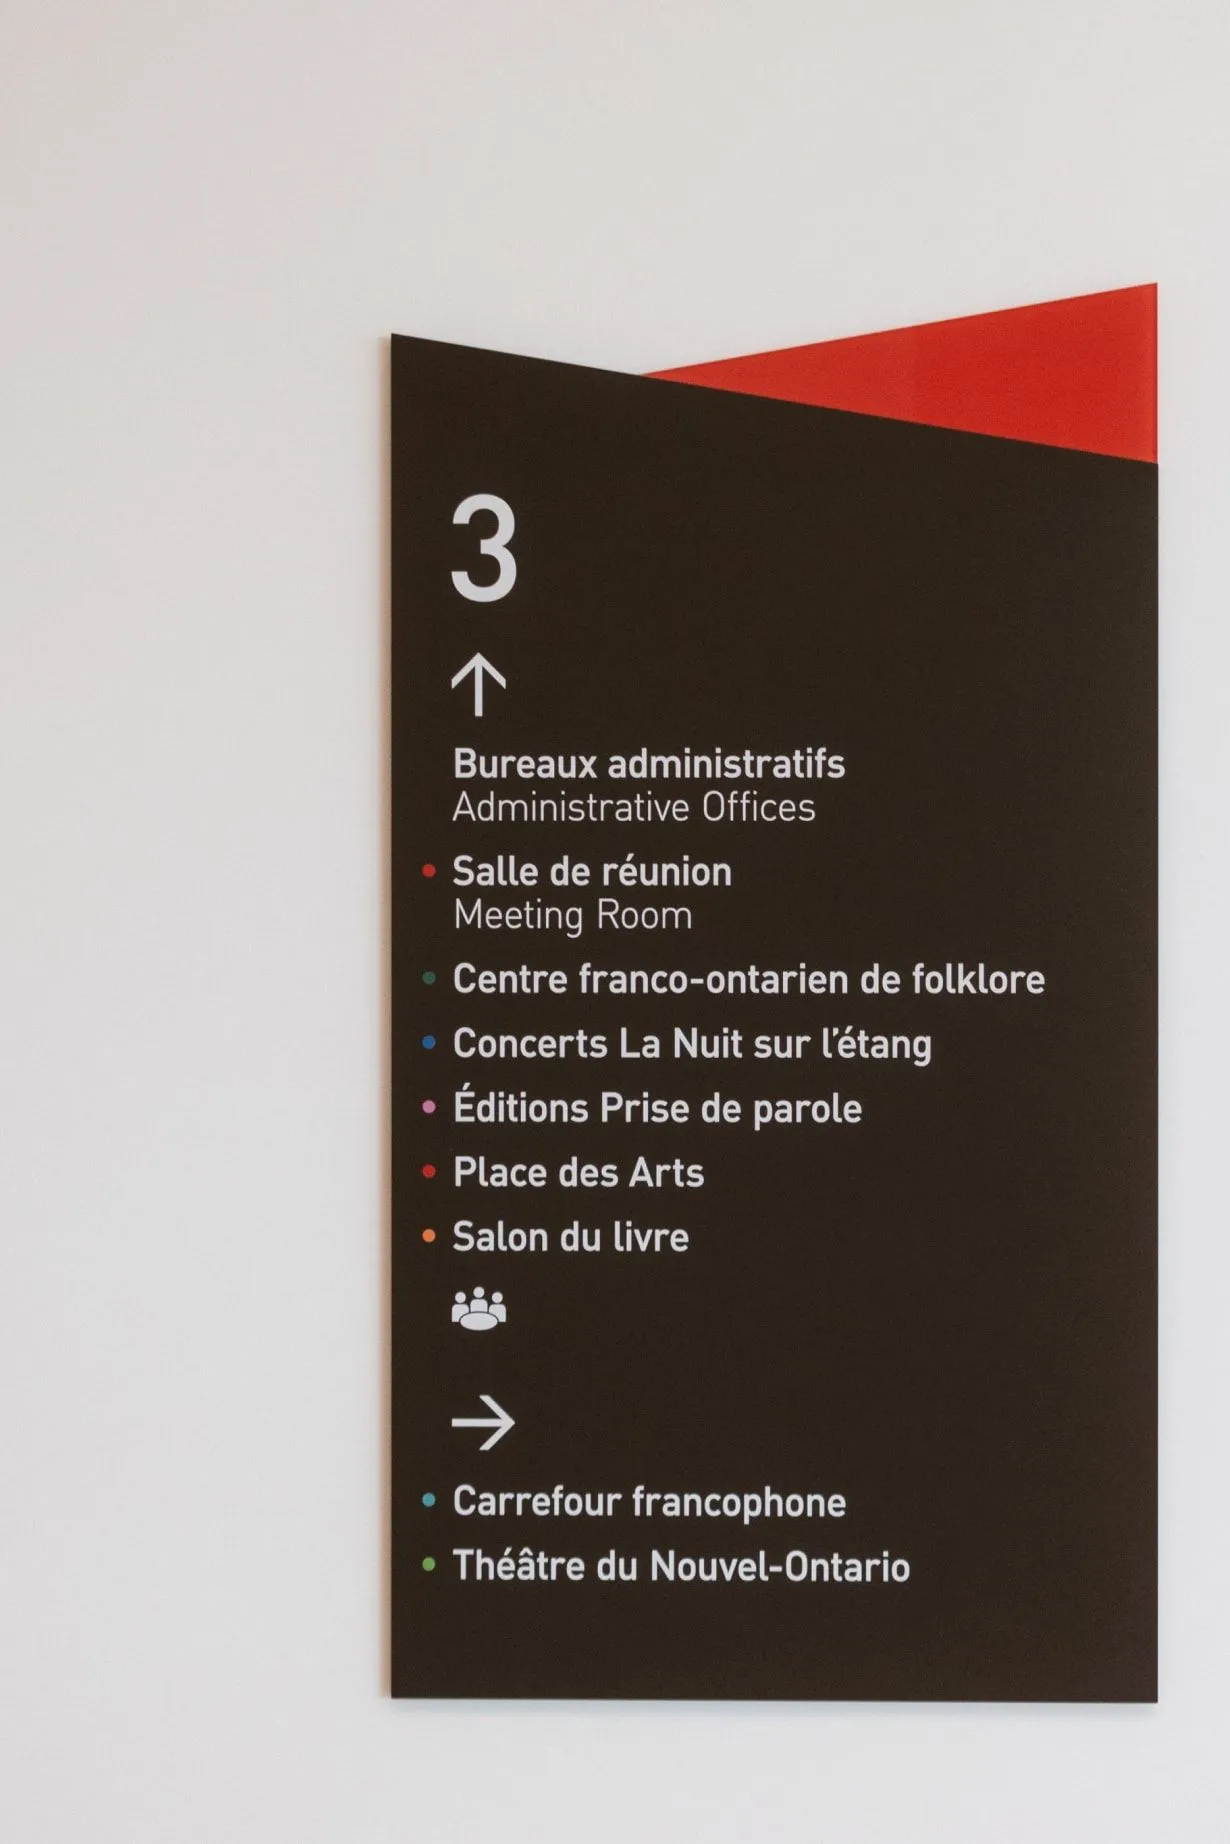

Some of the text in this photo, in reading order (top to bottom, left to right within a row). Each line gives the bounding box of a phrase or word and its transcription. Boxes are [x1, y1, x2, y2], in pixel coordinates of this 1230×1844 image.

[451, 493, 517, 603] 3
[454, 746, 846, 779] Bureaux administratifs
[452, 790, 816, 822] Administrative Offices
[452, 852, 732, 887] Salle de réunion
[455, 897, 692, 939] Meeting Room
[454, 962, 1046, 995] Centre franco-ontarien de folklore
[454, 1026, 608, 1059] Concerts
[620, 1026, 660, 1059] La
[674, 1026, 743, 1059] Nuit
[753, 1035, 812, 1059] sur
[454, 1081, 863, 1132] Éditions Prise de parole
[454, 1155, 705, 1188] Place des Arts
[452, 1219, 690, 1253] Salon du livre
[454, 1484, 847, 1525] Carrefour francophone
[452, 1546, 911, 1583] Théâtre du Nouvel-Ontario
